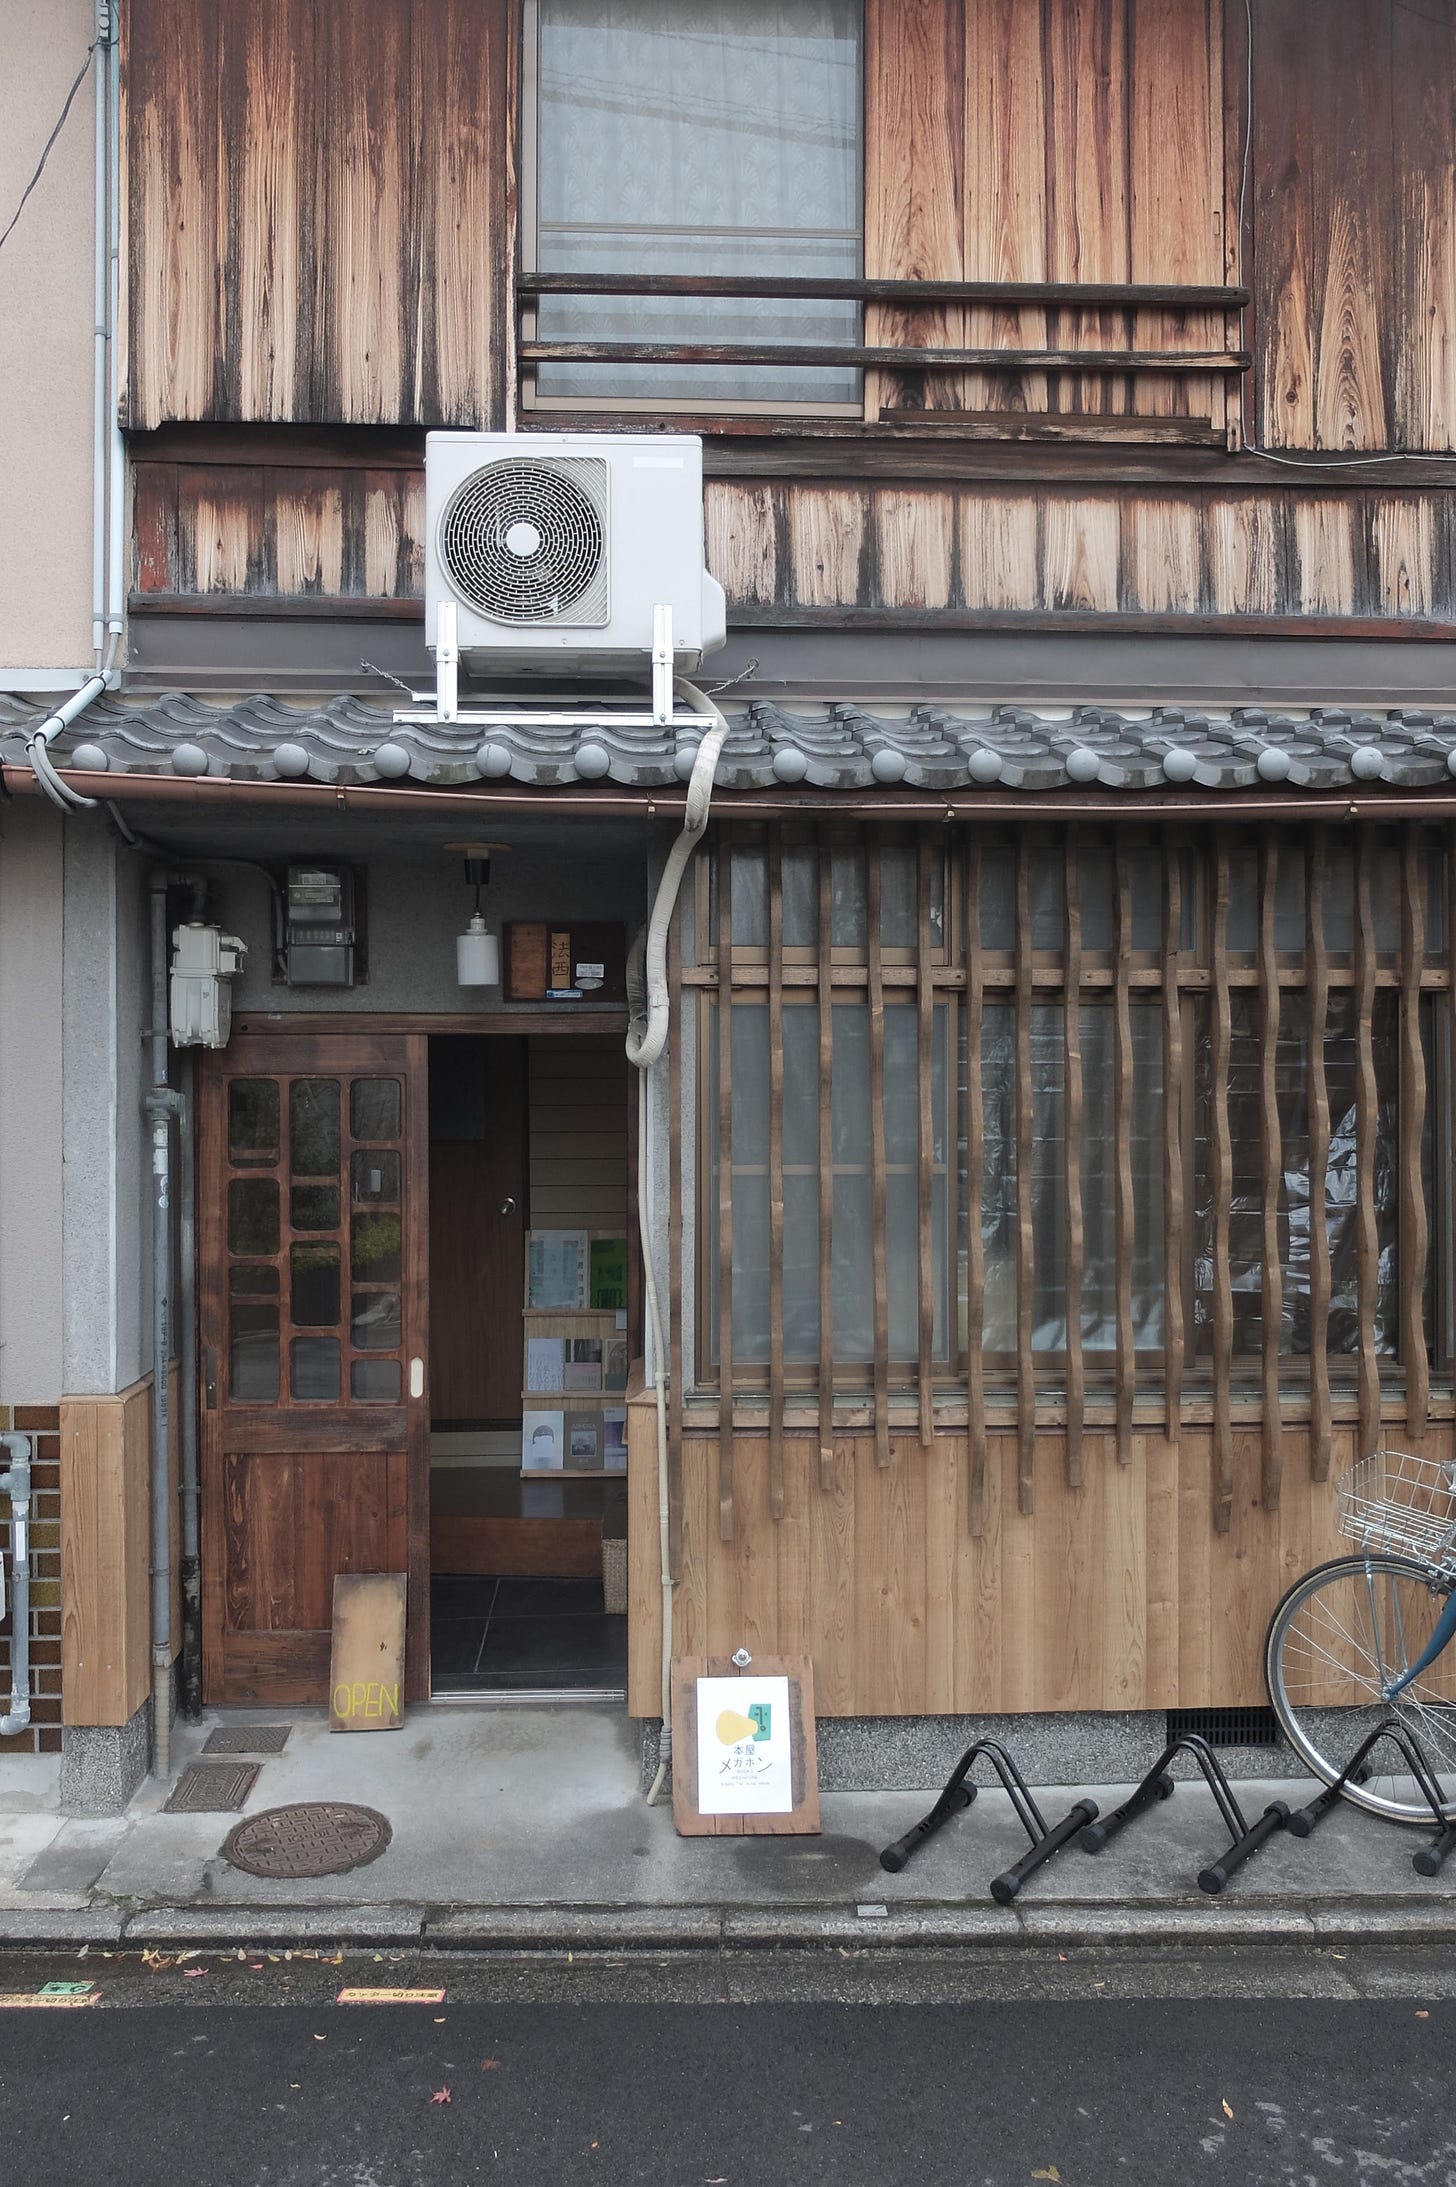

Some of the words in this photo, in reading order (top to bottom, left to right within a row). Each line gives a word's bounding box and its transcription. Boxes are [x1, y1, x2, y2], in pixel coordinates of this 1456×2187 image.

[333, 1682, 399, 1718] OPEN
[733, 1744, 755, 1755] 本屋
[719, 1757, 773, 1774] メガホン
